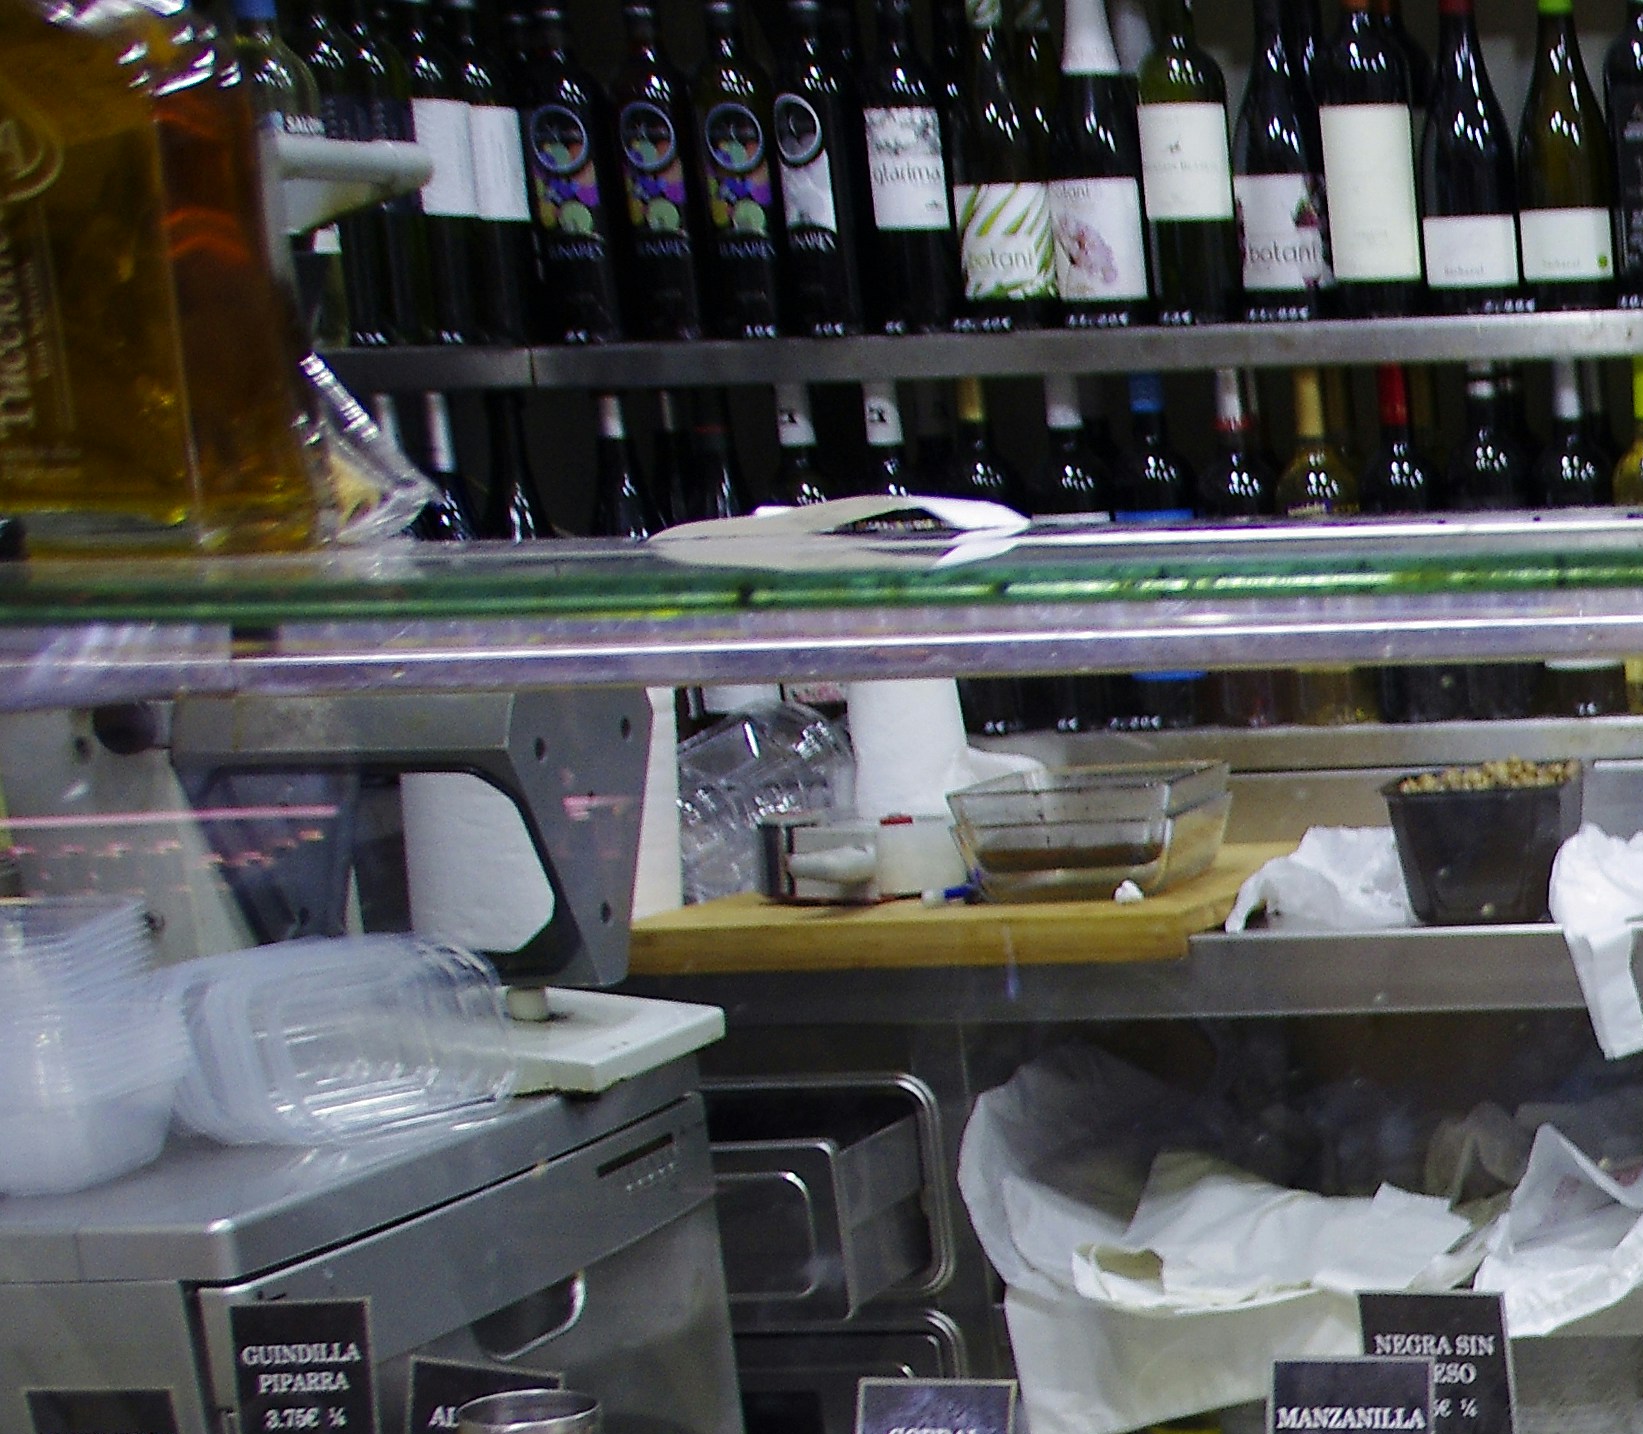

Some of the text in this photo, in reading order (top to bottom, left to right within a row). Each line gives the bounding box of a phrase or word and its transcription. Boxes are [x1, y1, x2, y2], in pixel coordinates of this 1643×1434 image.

[241, 1341, 361, 1365] GUINDILLA
[1374, 1334, 1496, 1357] NEGRA SIN
[258, 1371, 350, 1394] PIPARRA
[1275, 1407, 1427, 1430] MANZANILLA
